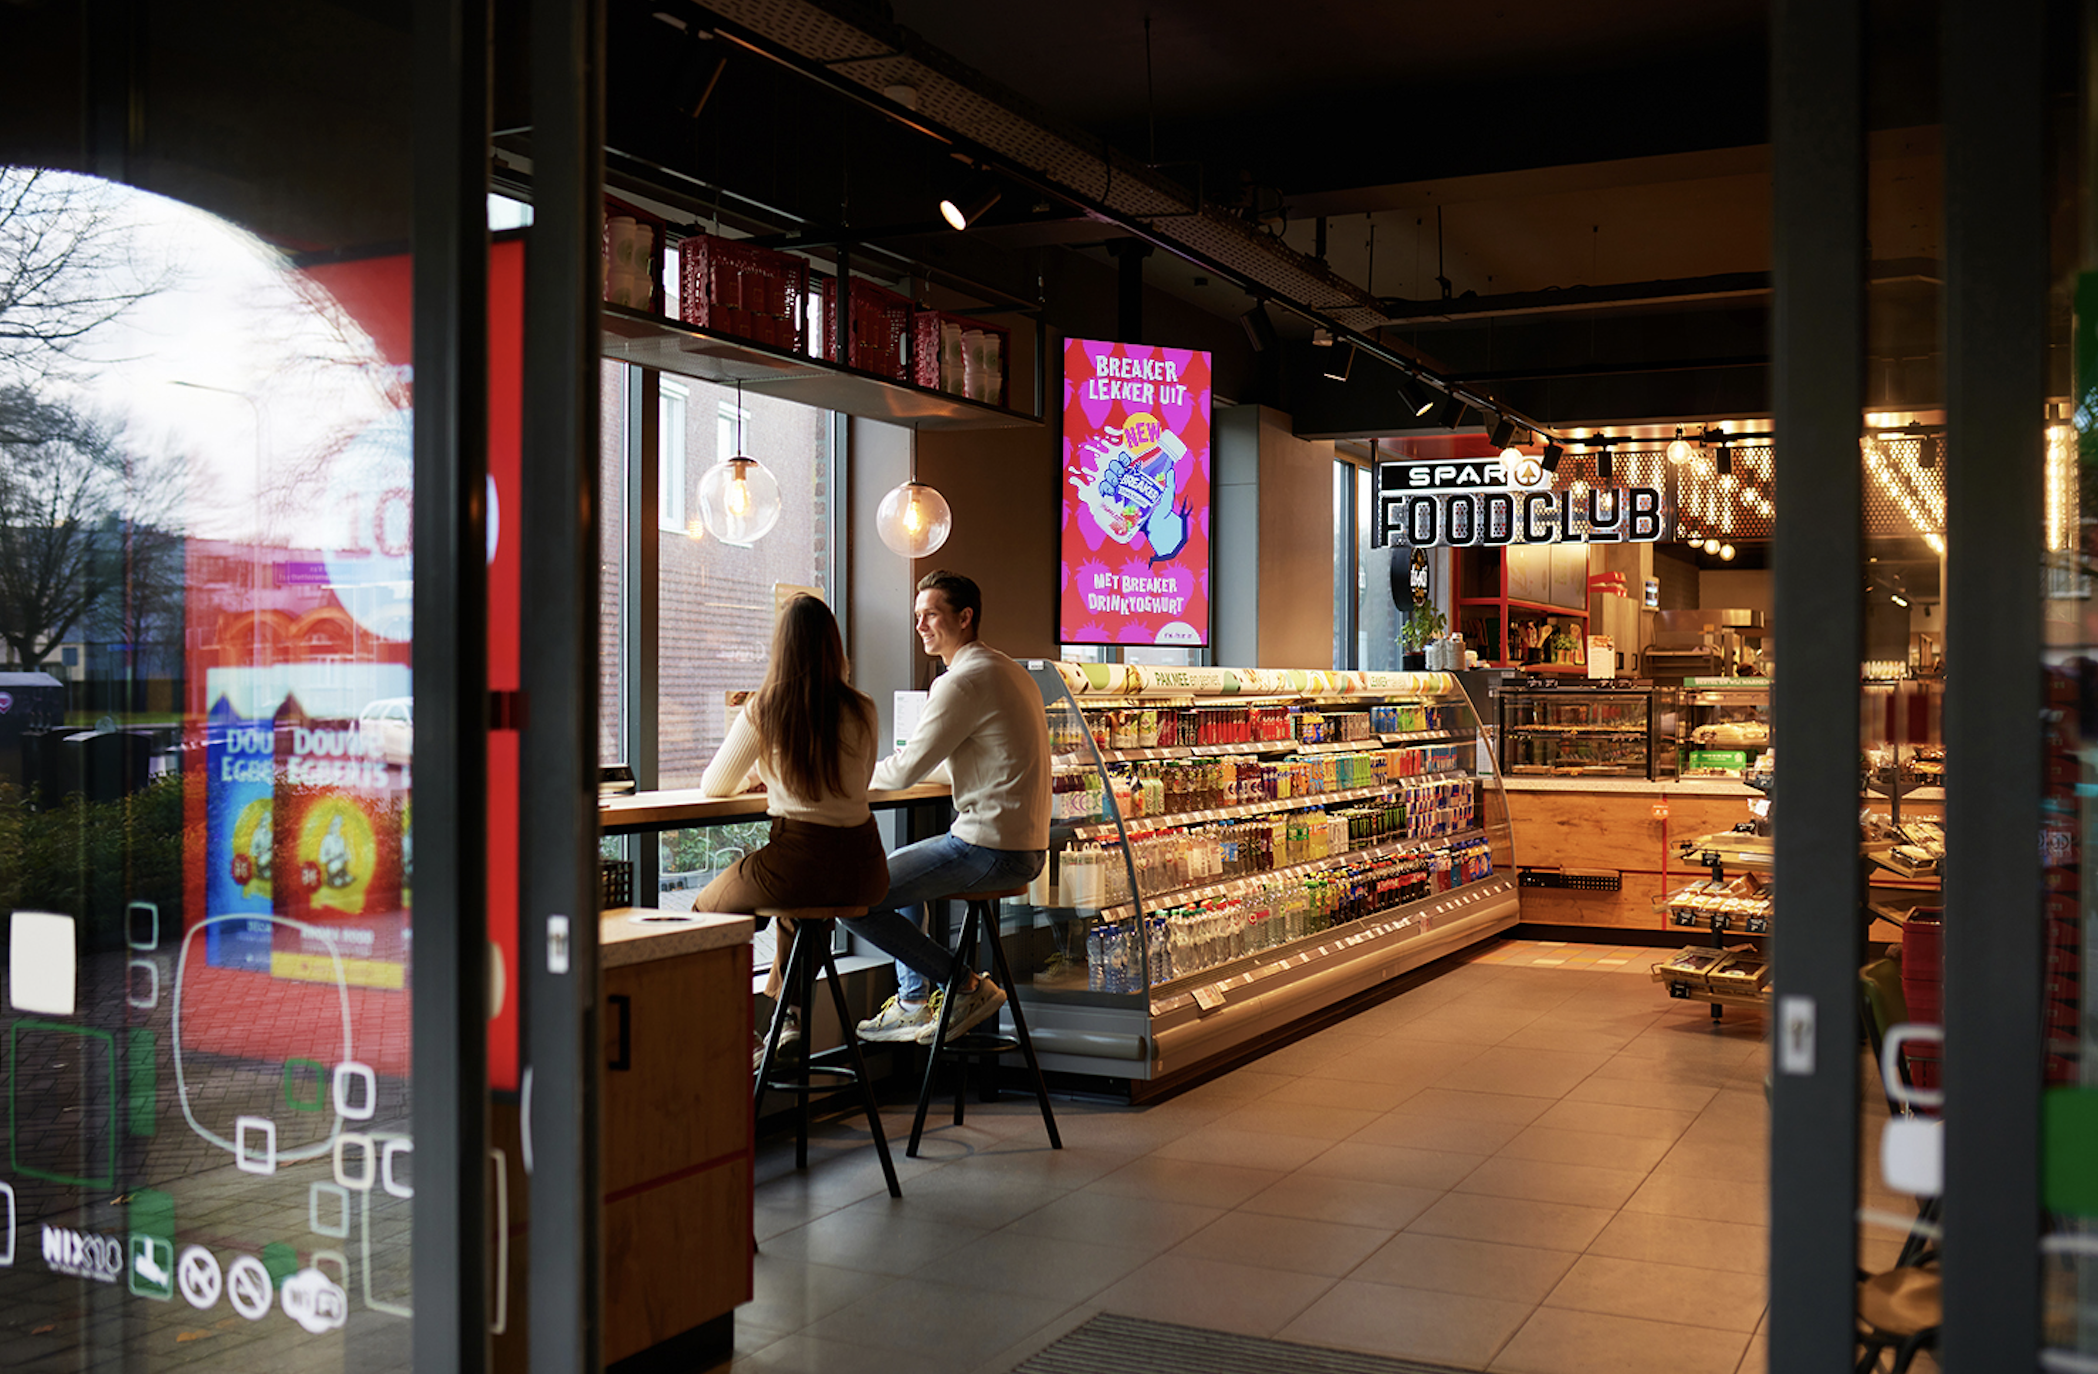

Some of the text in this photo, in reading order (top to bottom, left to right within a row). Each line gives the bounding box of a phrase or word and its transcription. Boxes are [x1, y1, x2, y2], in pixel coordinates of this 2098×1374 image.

[1096, 355, 1178, 382] BREAKER
[1089, 378, 1187, 406] LEKKER UIT
[1124, 422, 1161, 449] NEW
[1408, 465, 1508, 487] SPAR
[1381, 488, 1664, 547] FOODCLUB
[1093, 573, 1178, 594] MET BREAKER
[1088, 593, 1185, 615] DRINKYOGHURT
